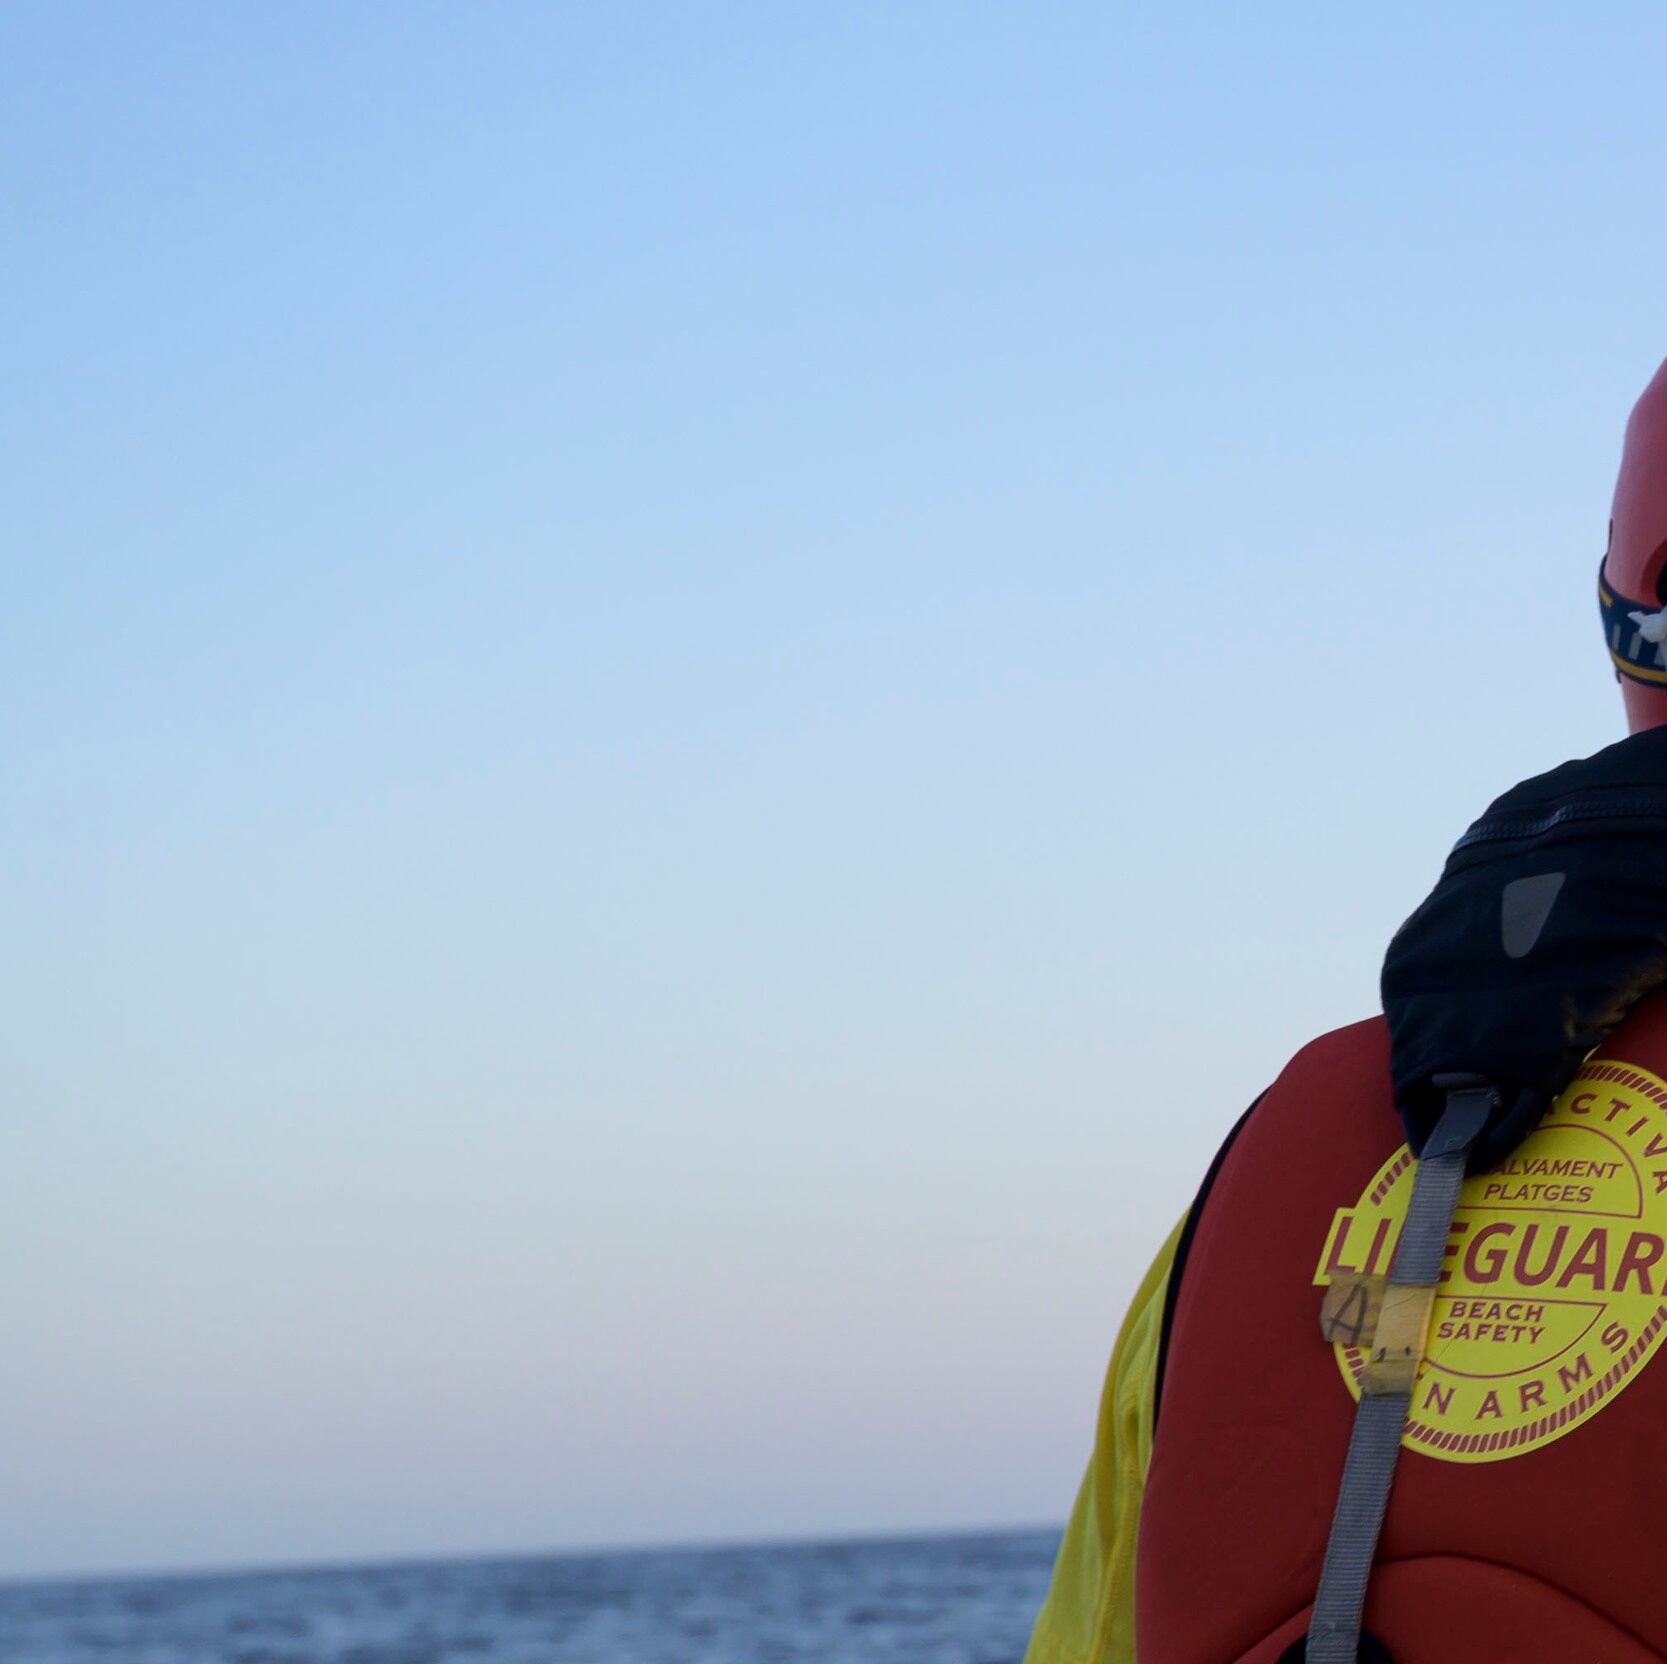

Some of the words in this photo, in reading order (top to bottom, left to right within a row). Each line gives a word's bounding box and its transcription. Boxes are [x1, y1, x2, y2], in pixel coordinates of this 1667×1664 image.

[1484, 1159, 1622, 1179] ALVAMENT
[1483, 1183, 1594, 1203] PLATGES
[1449, 1301, 1545, 1322] BEACH
[1436, 1322, 1546, 1344] SAFETY
[1475, 1321, 1629, 1420] ARMS
